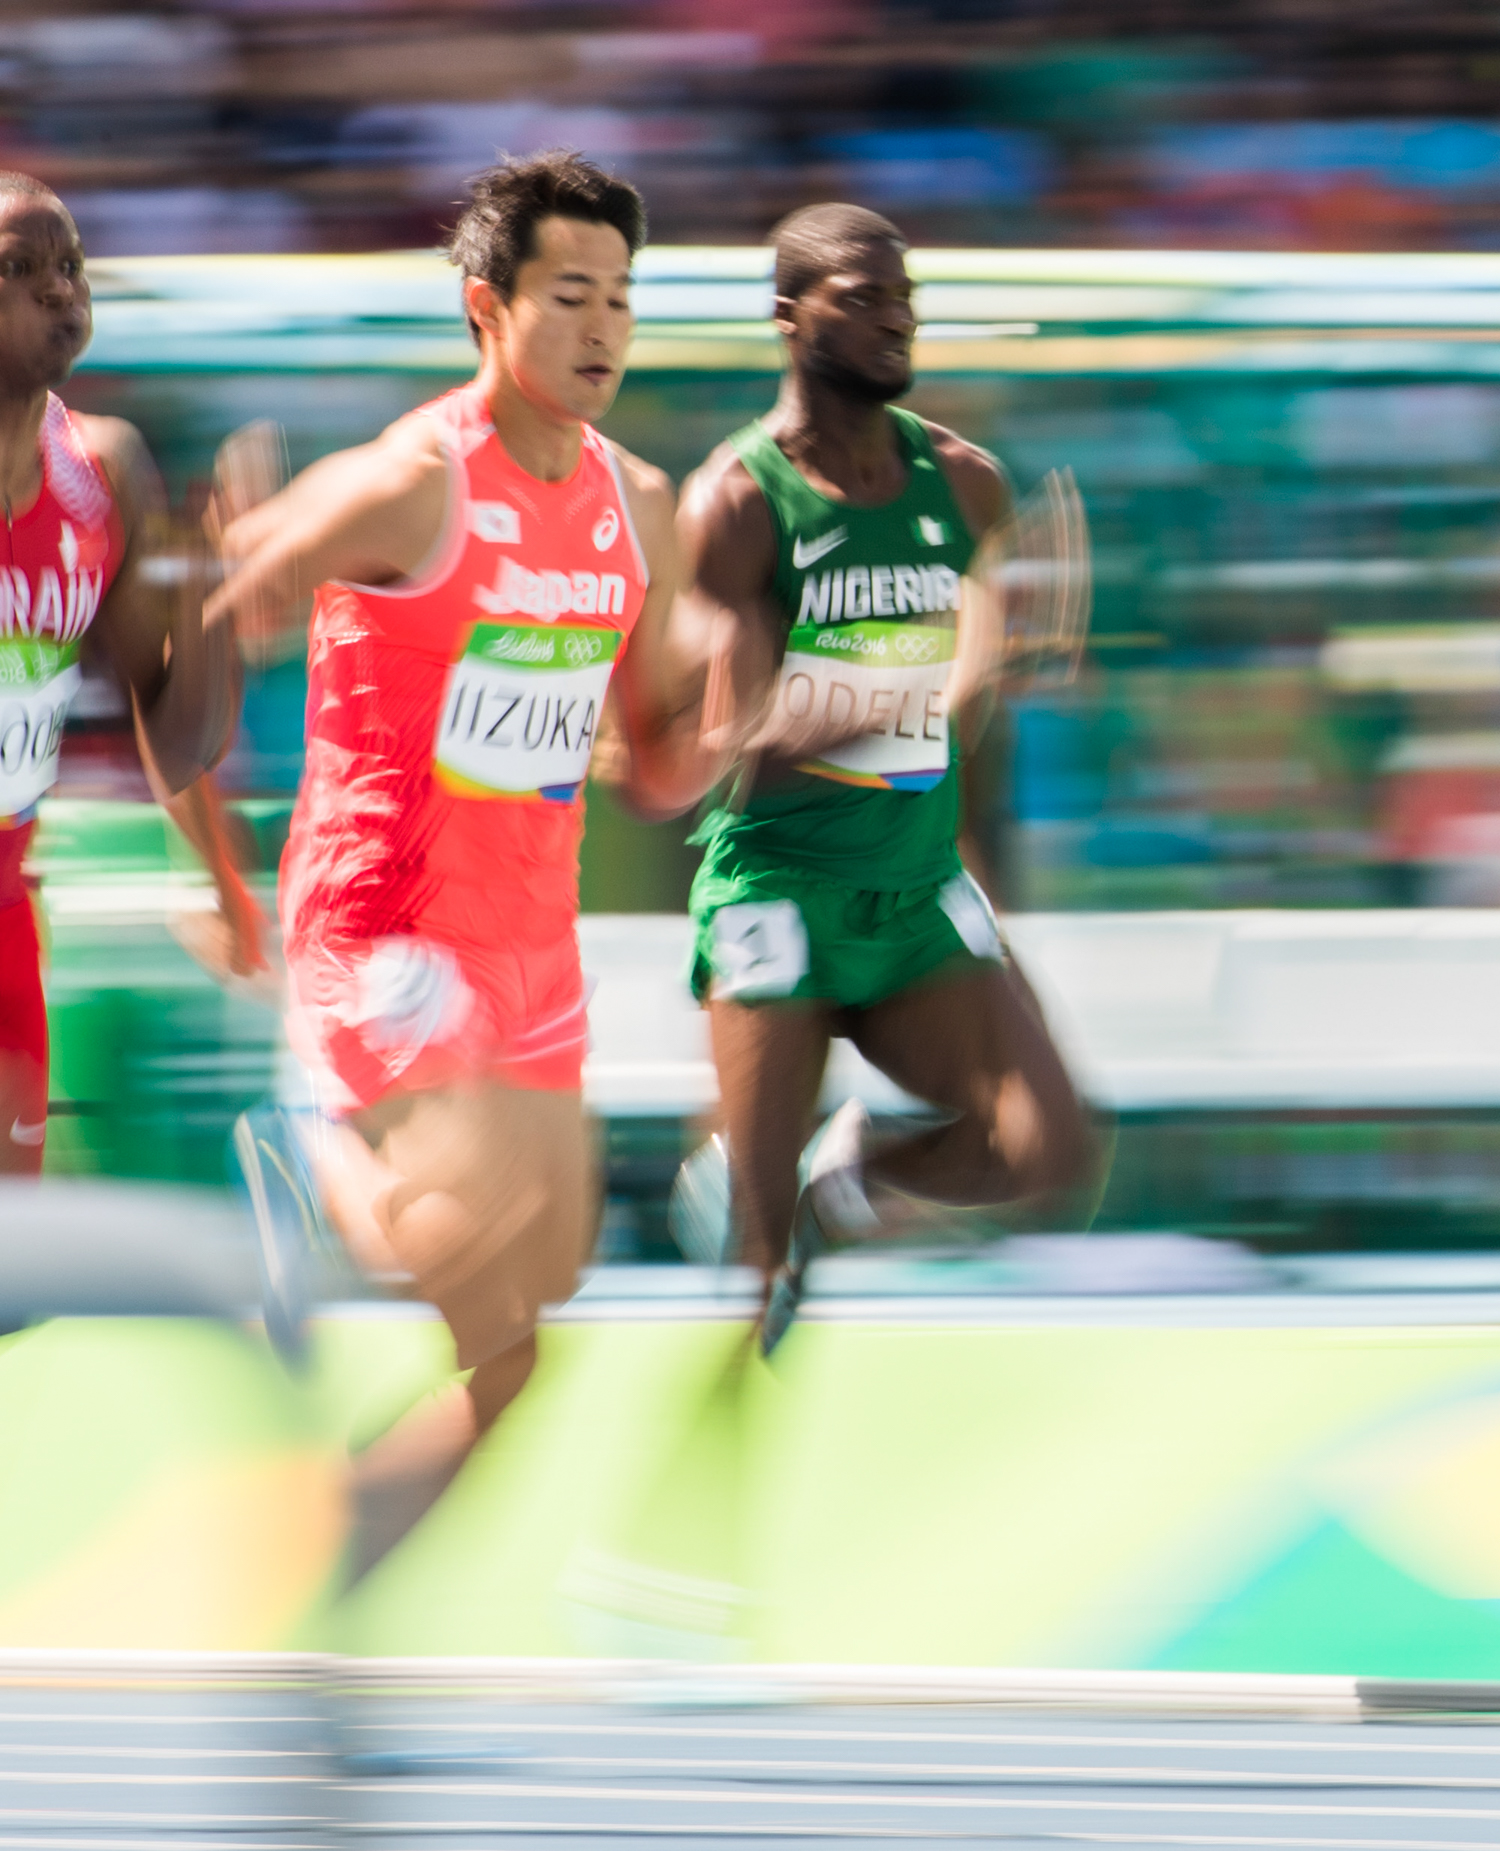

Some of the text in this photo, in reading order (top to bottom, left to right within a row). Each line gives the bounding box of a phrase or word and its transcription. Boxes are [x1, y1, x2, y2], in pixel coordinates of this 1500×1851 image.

[0, 565, 104, 645] RAIN
[472, 556, 627, 622] Japan
[797, 563, 960, 626] NIGERIA
[445, 680, 596, 751] IIZUKA
[783, 672, 943, 741] ODELE
